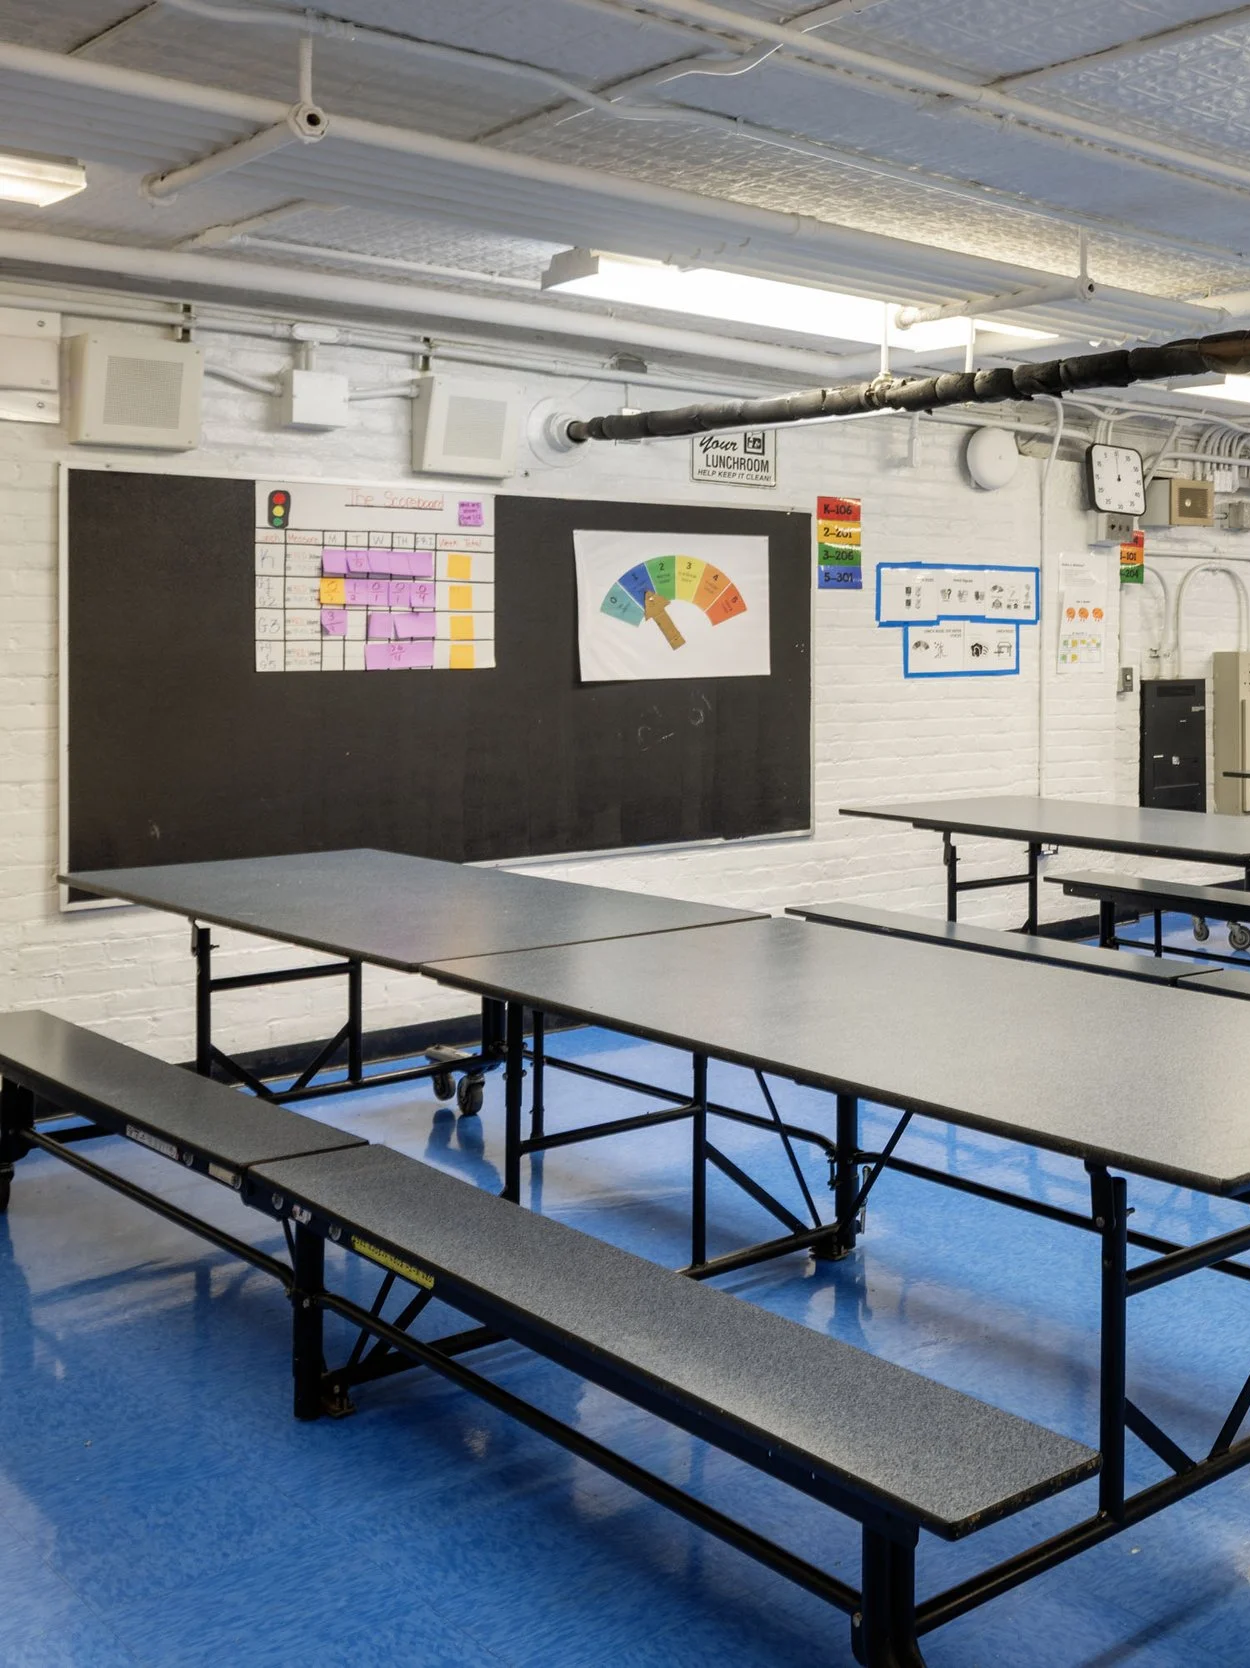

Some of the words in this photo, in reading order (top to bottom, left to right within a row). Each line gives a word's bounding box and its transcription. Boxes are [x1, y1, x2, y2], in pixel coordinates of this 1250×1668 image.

[699, 436, 738, 453] Your
[705, 454, 769, 473] LUNCHROOM
[718, 470, 736, 478] KEEP
[346, 487, 374, 505] The
[383, 490, 445, 508] Scoreboard
[823, 504, 852, 515] K-106
[823, 527, 852, 538] 2-201
[373, 536, 384, 544] W
[823, 550, 853, 560] 3-206
[659, 562, 665, 570] 2
[686, 562, 692, 570] 3
[824, 572, 853, 583] 5-301
[1120, 569, 1138, 578] -204
[610, 596, 618, 604] 0
